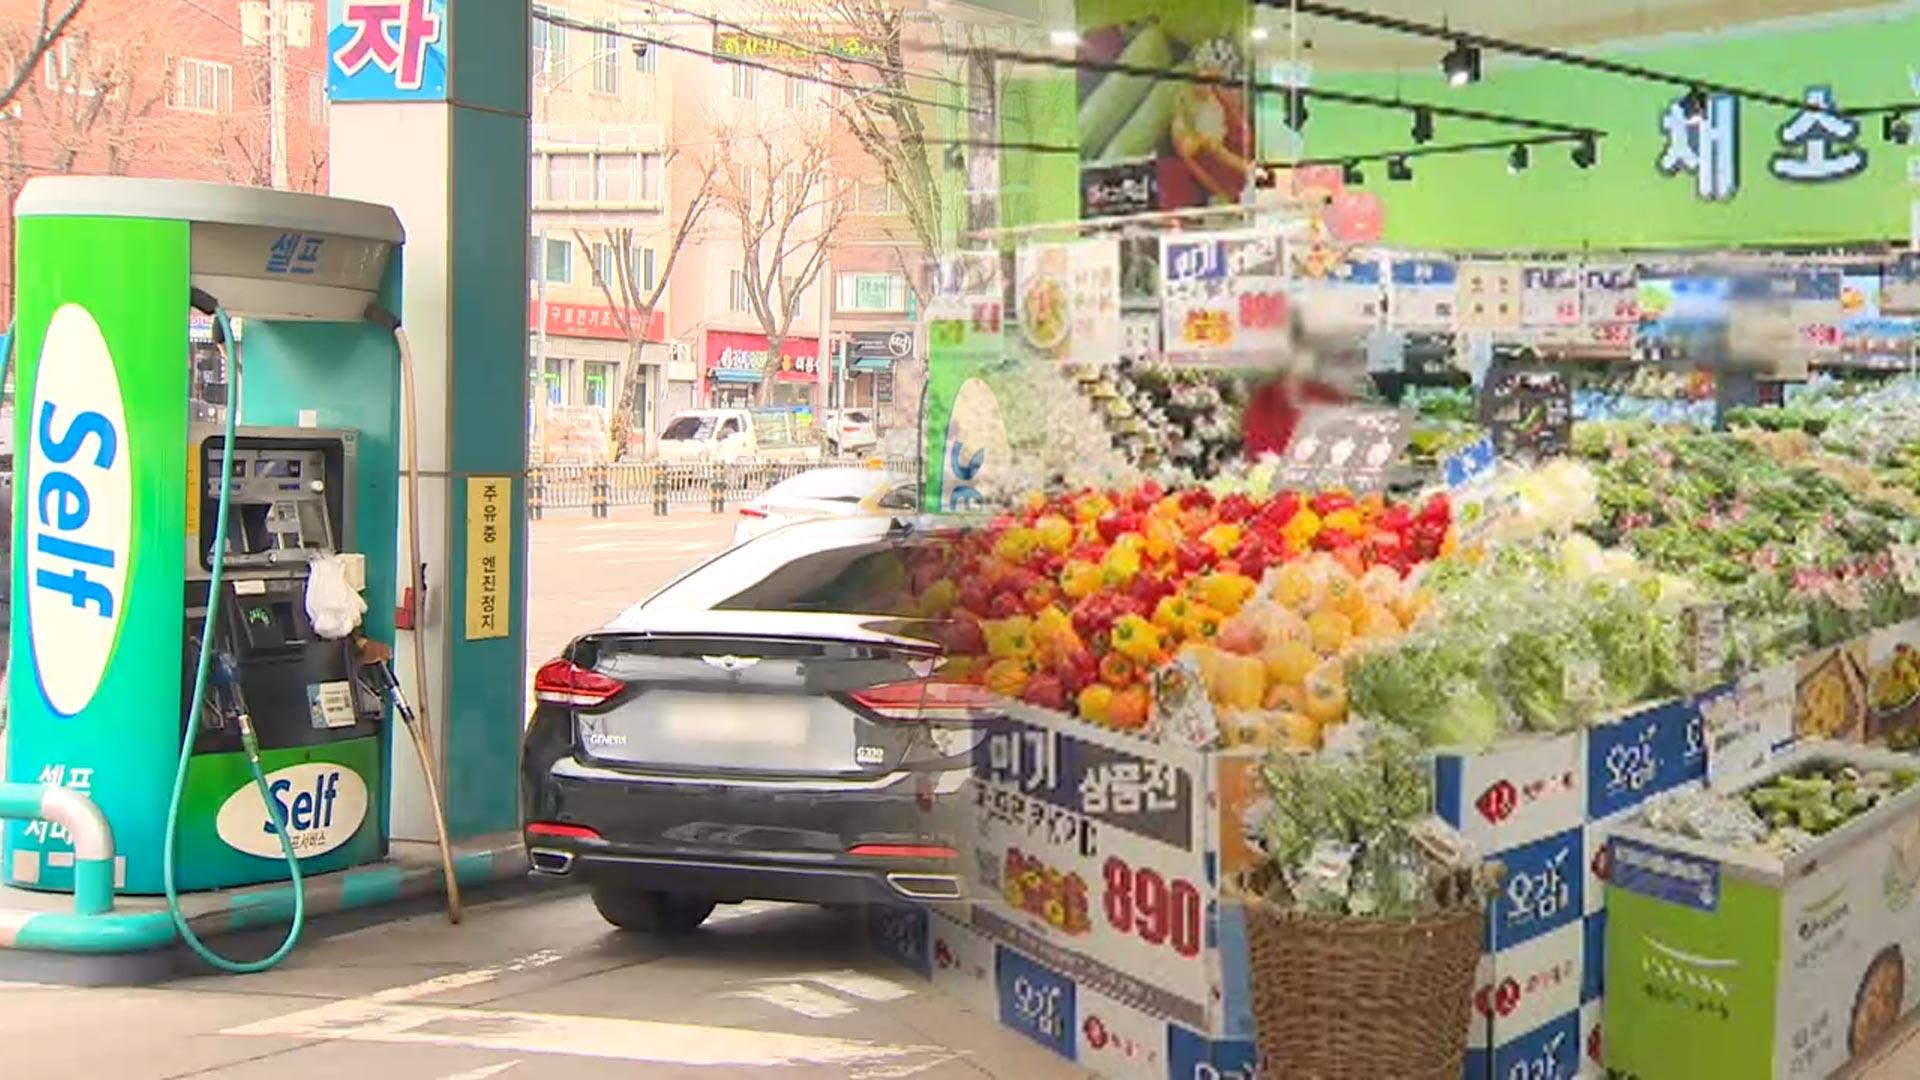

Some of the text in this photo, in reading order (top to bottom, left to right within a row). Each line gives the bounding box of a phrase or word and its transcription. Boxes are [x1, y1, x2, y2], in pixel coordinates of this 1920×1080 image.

[333, 0, 441, 90] 자
[1657, 86, 1868, 201] 채소
[265, 233, 325, 273] 셀프
[36, 400, 118, 619] Self
[481, 485, 498, 631] 주유중 엔진정지
[590, 734, 628, 745] GENESIS
[263, 772, 340, 835] Self
[1078, 763, 1177, 814] 상품전
[282, 831, 327, 852] 프서비스
[1102, 854, 1200, 959] 890
[1507, 846, 1569, 920] 오감
